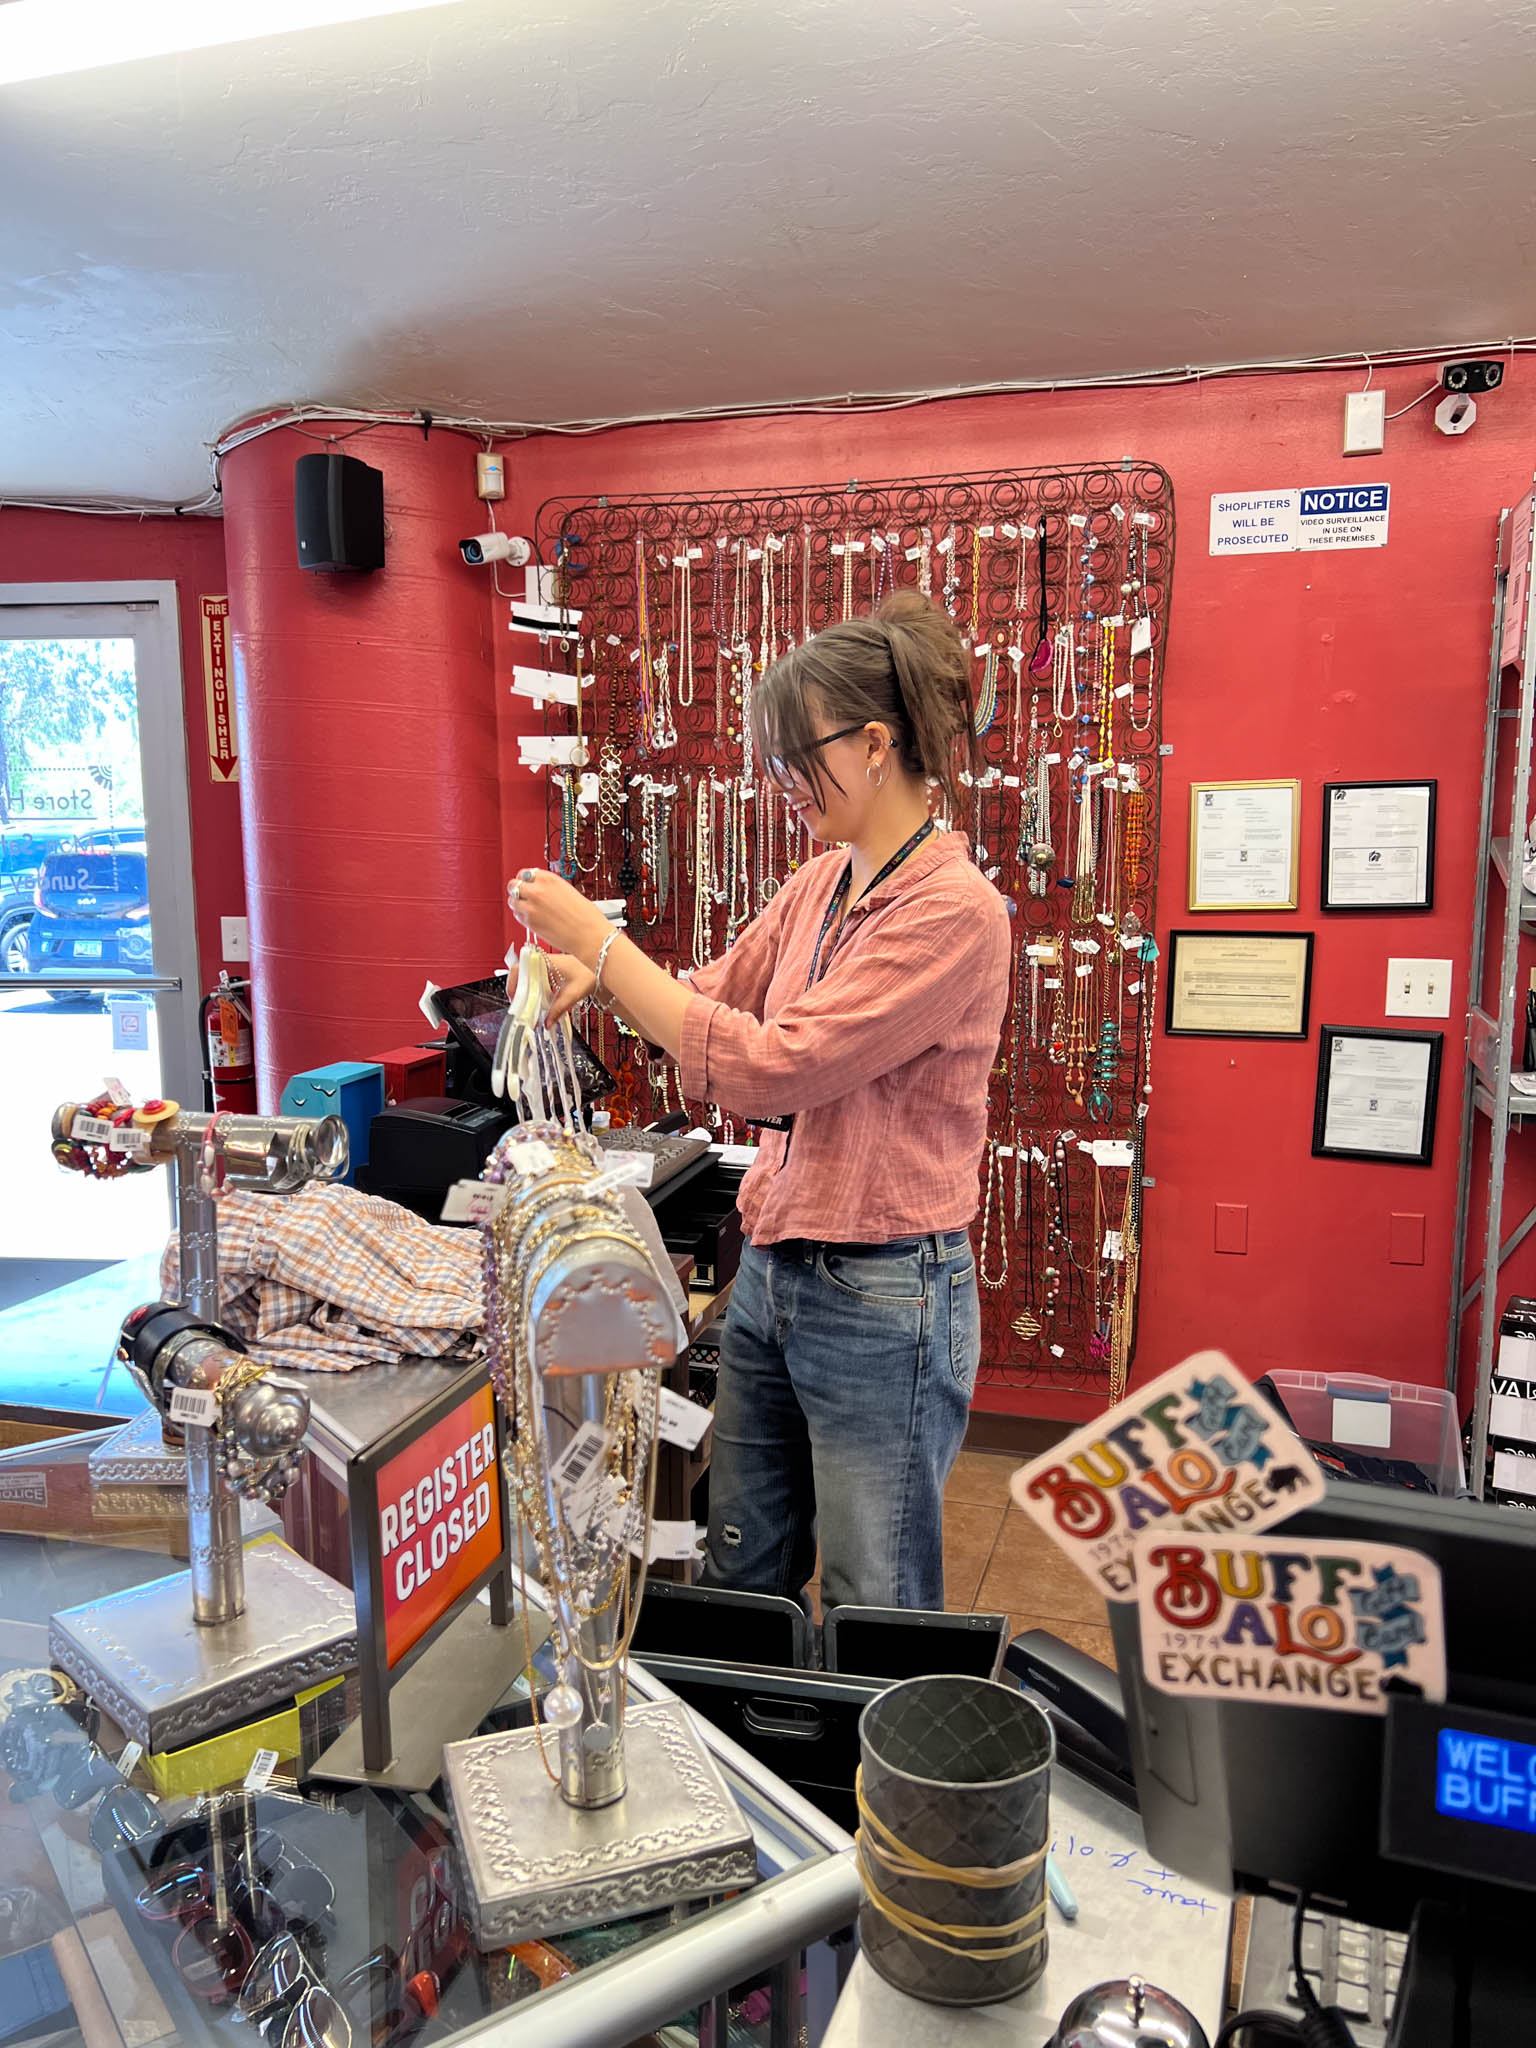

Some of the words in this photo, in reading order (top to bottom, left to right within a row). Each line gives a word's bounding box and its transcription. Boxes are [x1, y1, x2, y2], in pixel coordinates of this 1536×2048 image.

[1218, 499, 1291, 512] SHOPLIFTERS
[1304, 490, 1384, 512] NOTICE
[1232, 519, 1257, 528] WILL
[1260, 517, 1275, 527] BE
[1300, 518, 1324, 526] VIDEO
[1326, 515, 1385, 525] SURVEILLANCE
[1332, 526, 1348, 534] USE
[1217, 533, 1289, 546] PROSECUTED
[1335, 534, 1375, 543] PREMISES
[205, 604, 228, 616] FIRE
[212, 620, 230, 760] EXTINGUISHER
[381, 1422, 496, 1557] REGISTER
[395, 1481, 491, 1601] CLOSED
[1161, 1631, 1222, 1650] 1974
[1157, 1651, 1379, 1702] EXCHANGE
